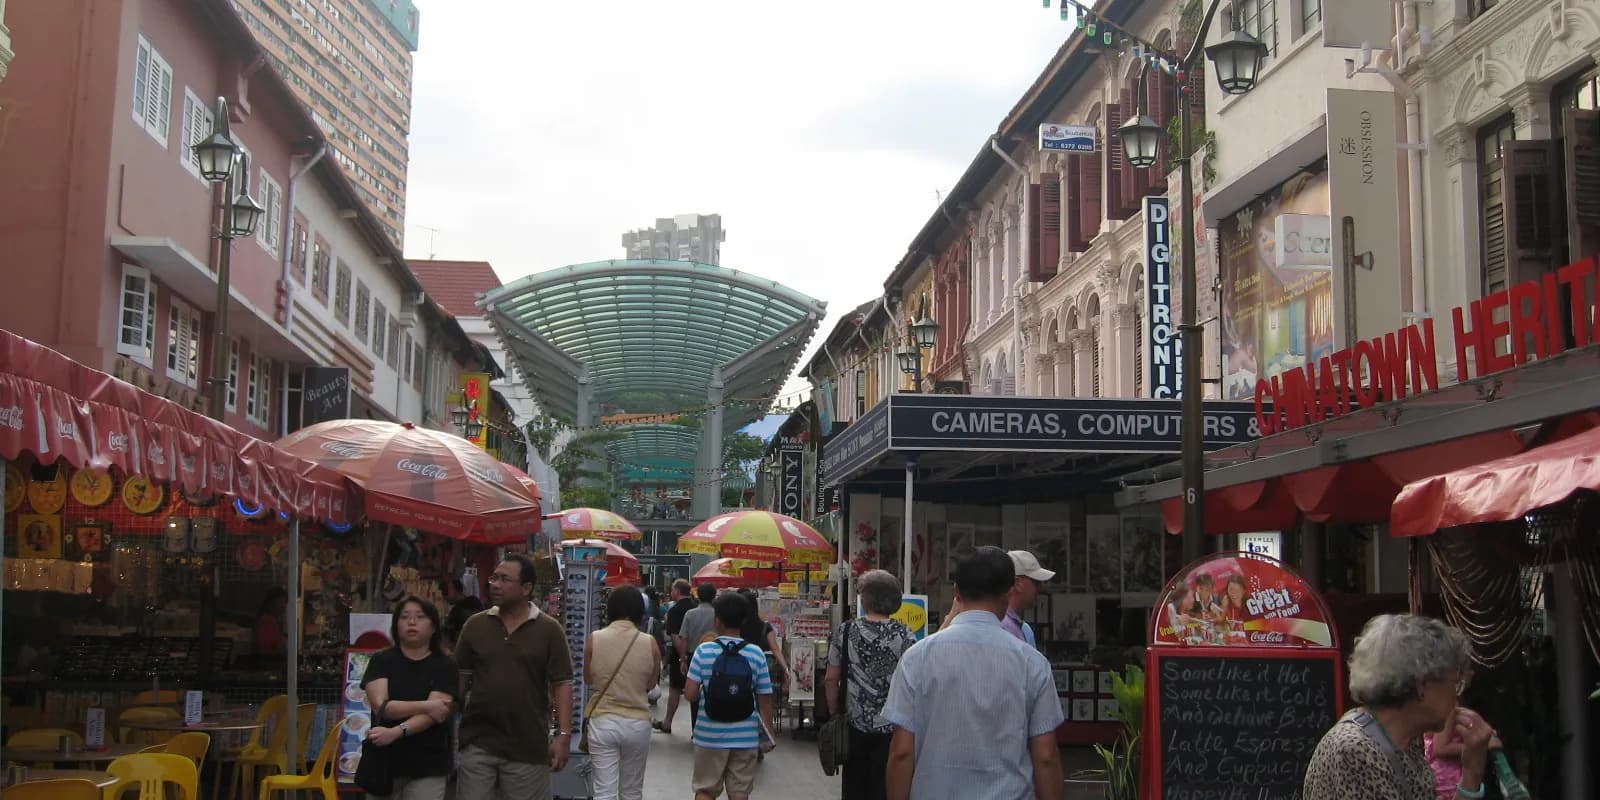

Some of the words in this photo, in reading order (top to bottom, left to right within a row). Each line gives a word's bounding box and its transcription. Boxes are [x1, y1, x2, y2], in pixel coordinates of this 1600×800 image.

[1339, 137, 1356, 155] 迷
[1361, 110, 1374, 185] OBSESSION
[305, 374, 348, 401] Beauty
[322, 393, 343, 414] Art
[931, 411, 1067, 438] CAMERAS,
[1077, 413, 1235, 437] COMPUTRS
[397, 458, 448, 480] Coca-Cola
[1187, 487, 1196, 504] 6
[1248, 542, 1269, 553] tax
[1246, 588, 1292, 616] Great
